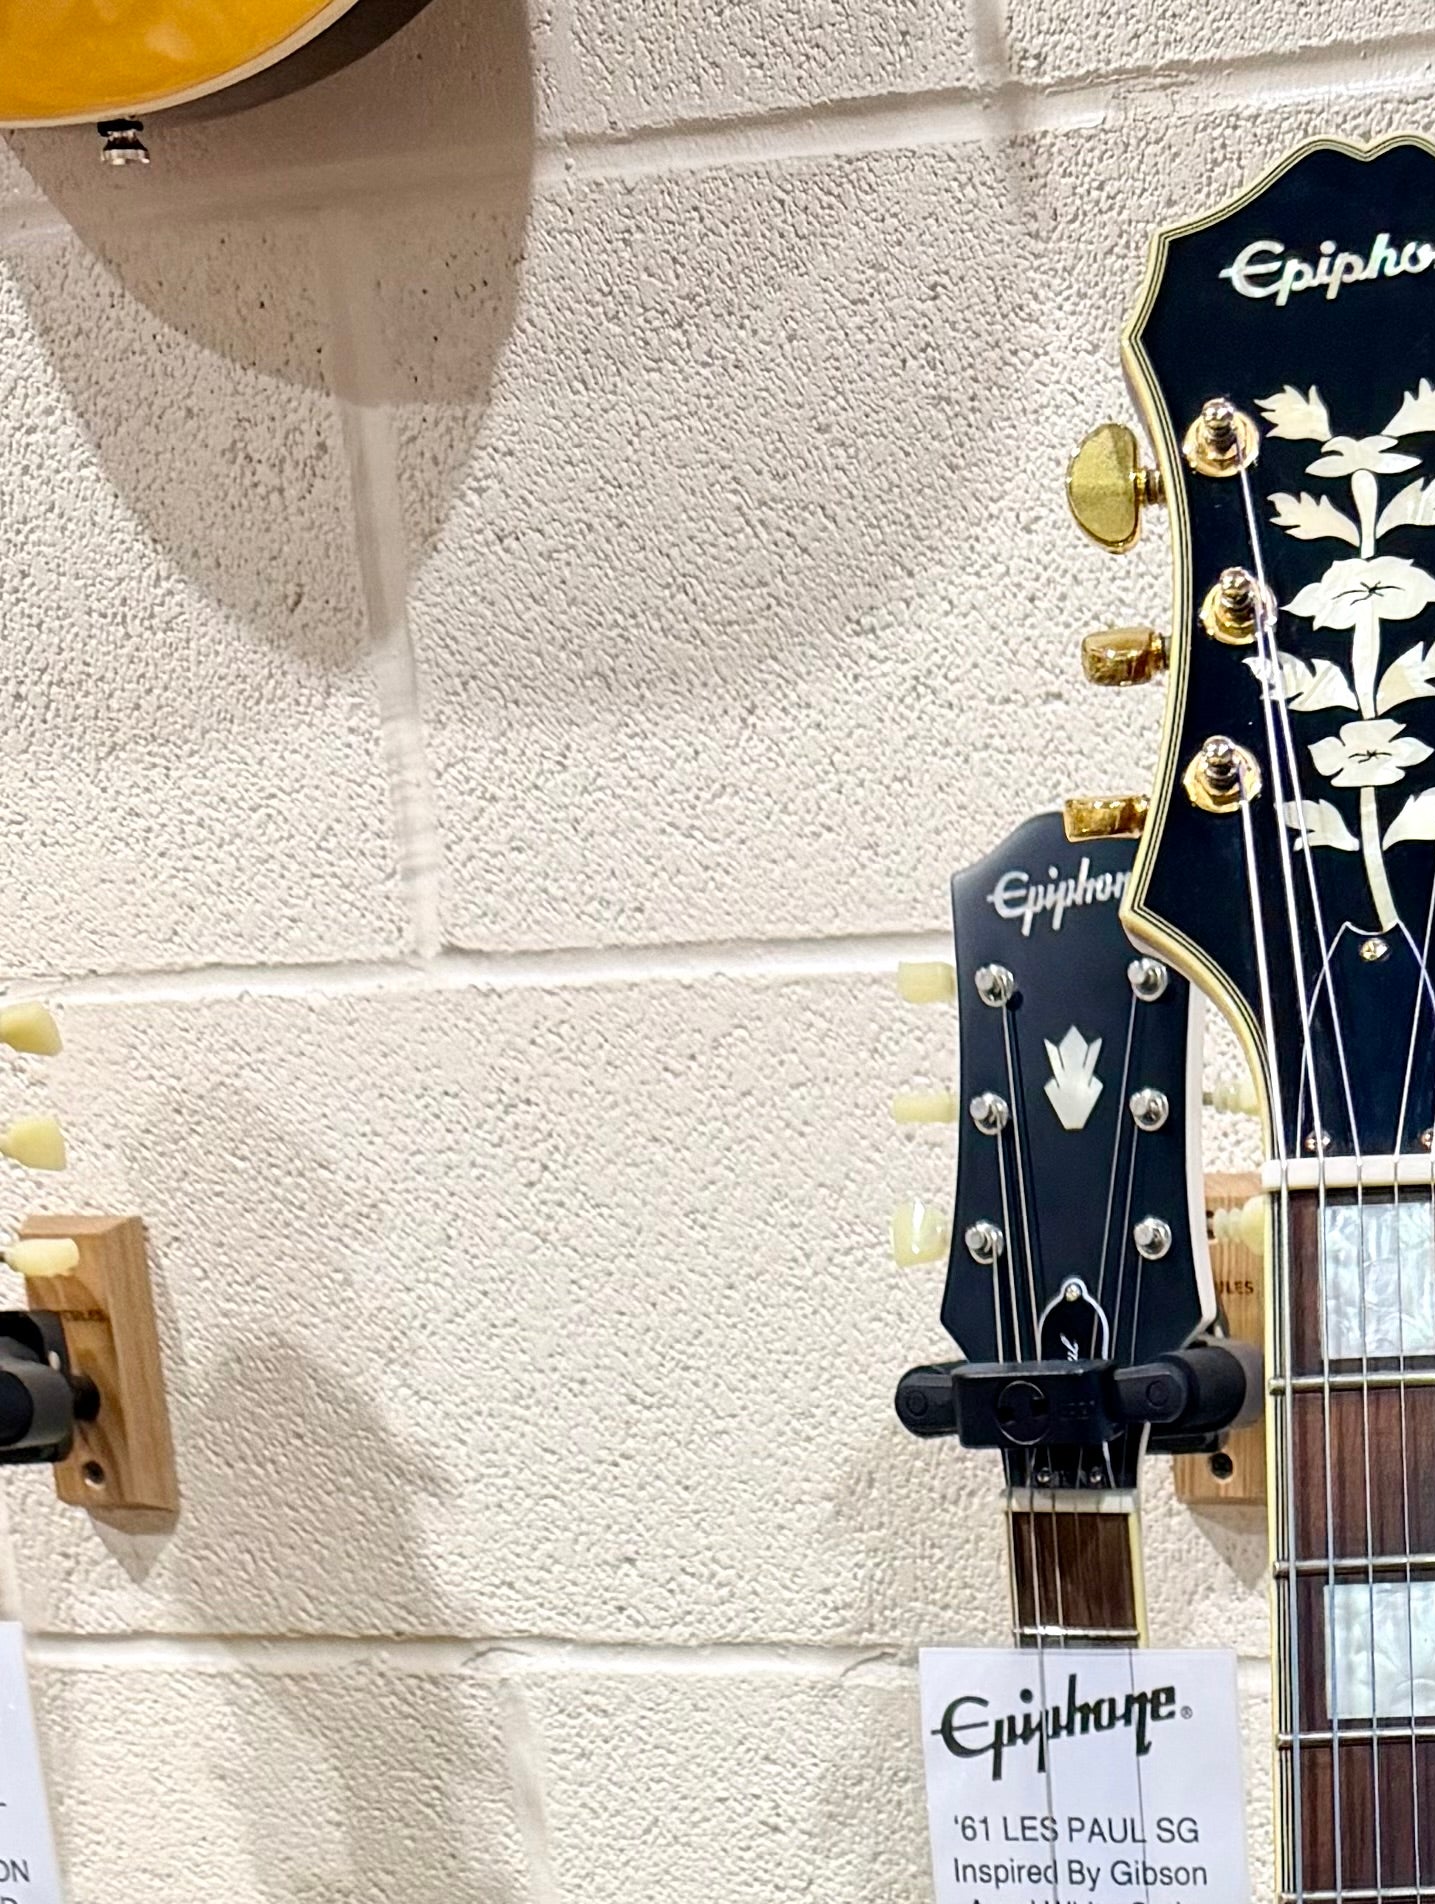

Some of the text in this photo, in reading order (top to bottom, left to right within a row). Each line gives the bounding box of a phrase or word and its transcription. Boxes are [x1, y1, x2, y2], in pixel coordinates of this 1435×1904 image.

[987, 857, 1131, 936] Epiphon
[1003, 1816, 1059, 1842] LES
[1069, 1818, 1146, 1843] PAUL
[1156, 1818, 1200, 1844] SG
[954, 1858, 1208, 1891] Inspired By Gibson
